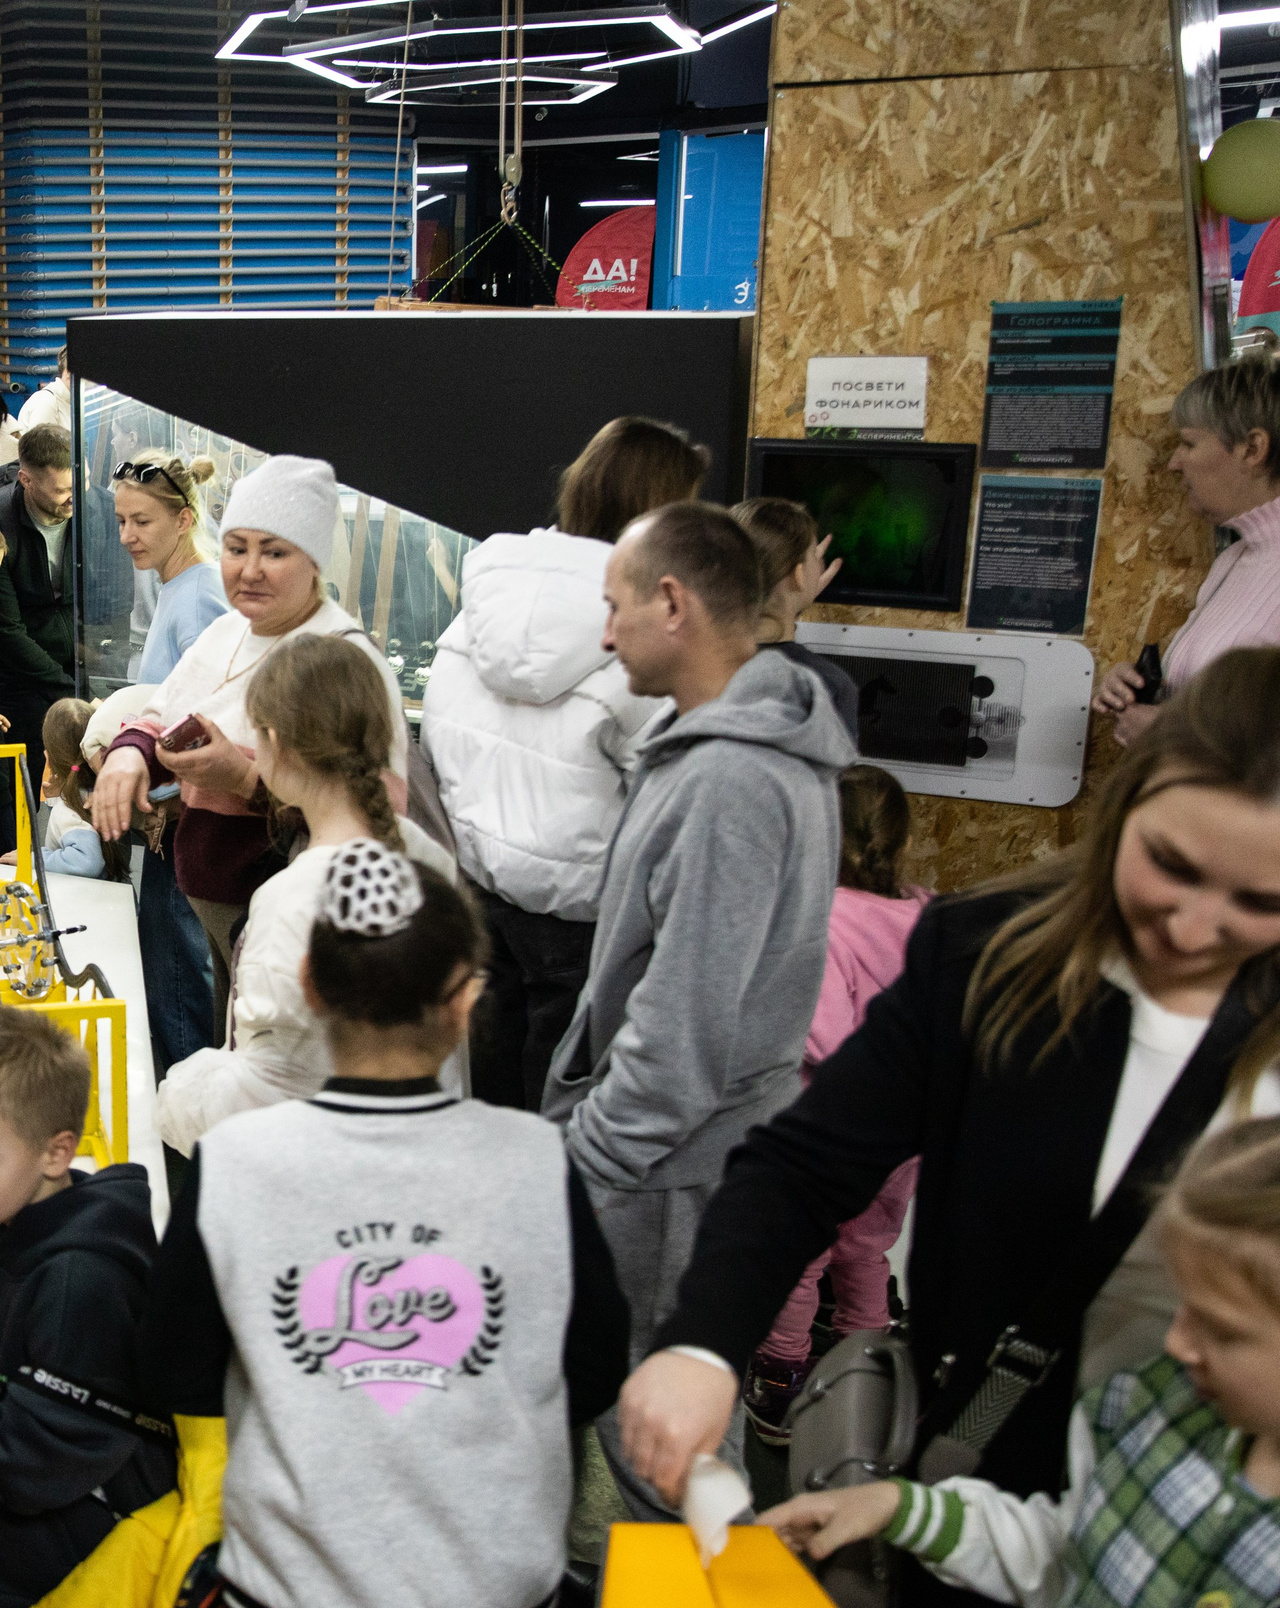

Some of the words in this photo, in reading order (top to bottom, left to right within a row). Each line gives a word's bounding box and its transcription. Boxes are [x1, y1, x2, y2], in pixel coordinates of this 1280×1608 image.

[582, 258, 639, 282] ДА!
[832, 381, 906, 392] ПОСВЕТИ
[815, 399, 921, 409] ФОНАРИКОМ
[335, 1222, 395, 1249] CITY
[411, 1224, 442, 1245] OF
[304, 1253, 458, 1358] Love
[379, 1363, 436, 1378] HEART
